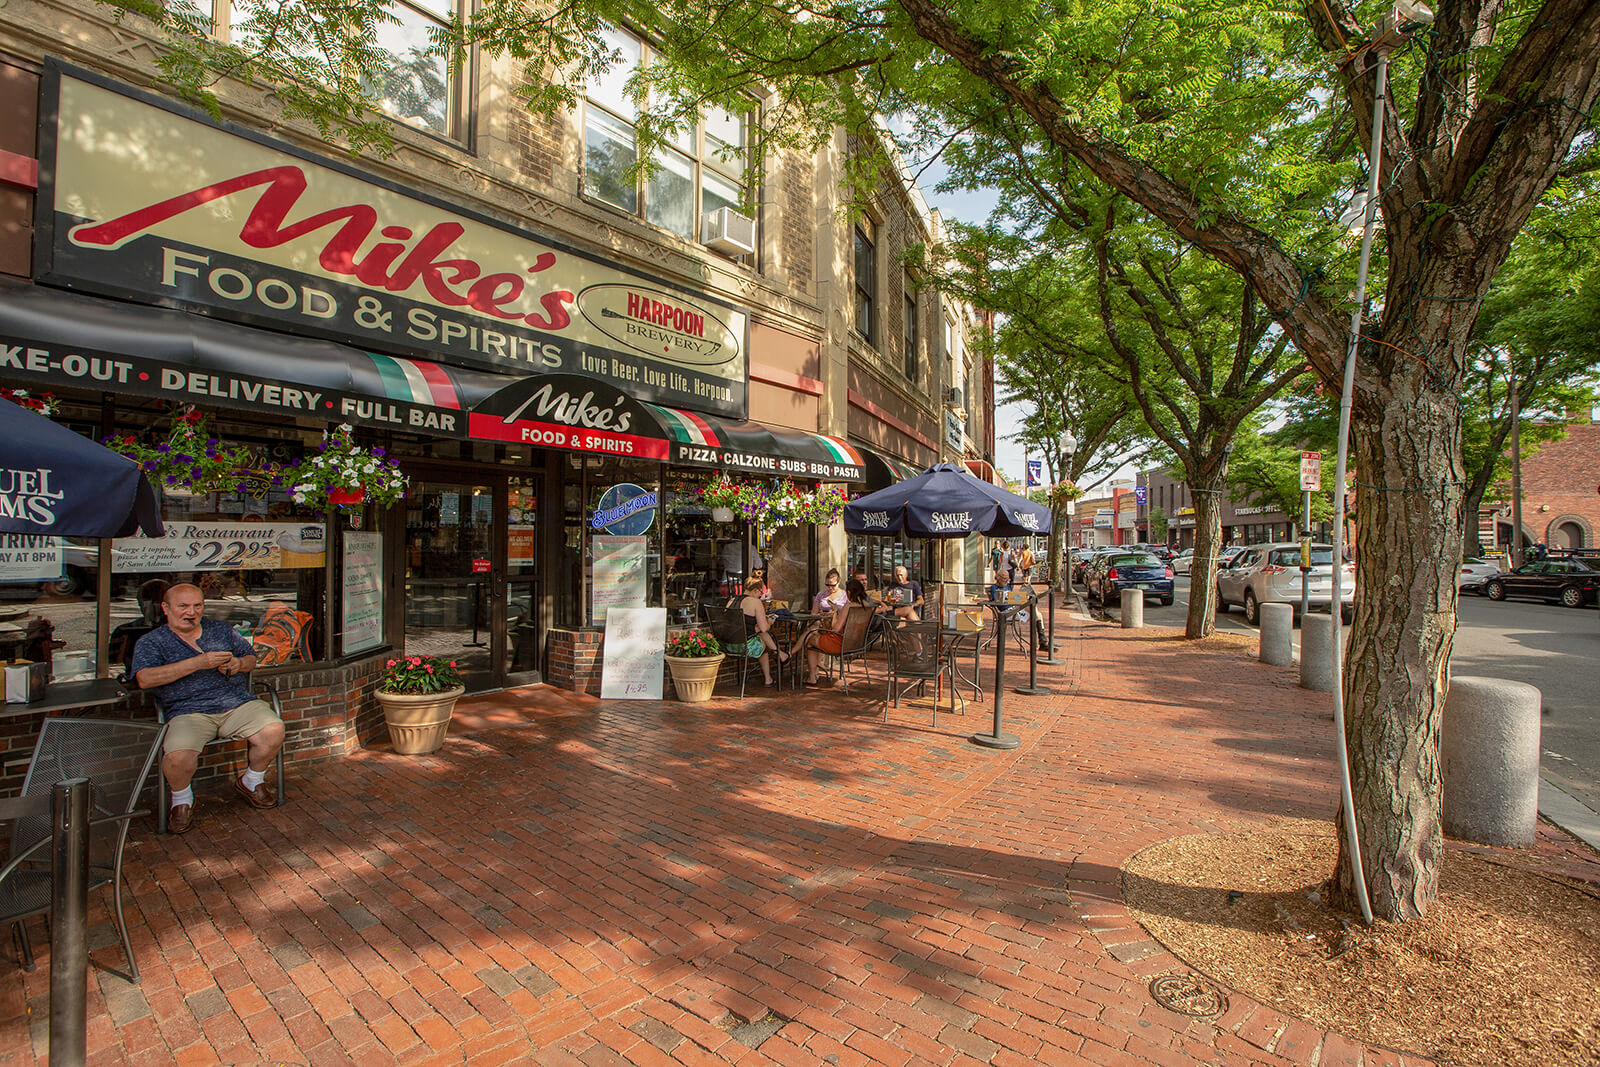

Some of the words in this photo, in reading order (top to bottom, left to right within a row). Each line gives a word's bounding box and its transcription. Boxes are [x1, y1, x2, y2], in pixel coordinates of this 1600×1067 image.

[73, 165, 575, 331] Mike's
[353, 295, 393, 333] &
[627, 291, 704, 338] HARPOON
[626, 322, 704, 353] BREWERY
[582, 351, 608, 376] Love
[611, 358, 640, 382] Beer.
[644, 365, 667, 388] Love
[670, 371, 691, 393] Life.
[694, 377, 734, 403] Harpoon.
[160, 367, 322, 411] DELIVERY
[341, 396, 403, 425] FULL
[408, 408, 457, 432] BAR
[502, 383, 632, 433] Mike's
[521, 427, 566, 446] FOOD
[571, 434, 583, 447] &
[585, 436, 633, 453] SPIRITS
[679, 446, 718, 464] PIZZA
[723, 452, 776, 470] CALZONE
[779, 458, 807, 474] SUBS
[811, 464, 830, 476] BBQ
[833, 465, 861, 479] PASTA
[862, 510, 890, 522] SAMUEL
[863, 518, 889, 530] ADAMS
[931, 511, 973, 524] SAMUEL
[935, 520, 970, 531] ADAMS
[182, 525, 275, 539] Restaurant
[16, 552, 29, 562] AT
[32, 552, 56, 562] 8PM
[117, 552, 139, 562] pizza
[155, 553, 182, 562] pitcher
[118, 546, 140, 554] Large
[148, 546, 176, 555] topping
[117, 561, 126, 569] of
[145, 560, 173, 568] Adams!
